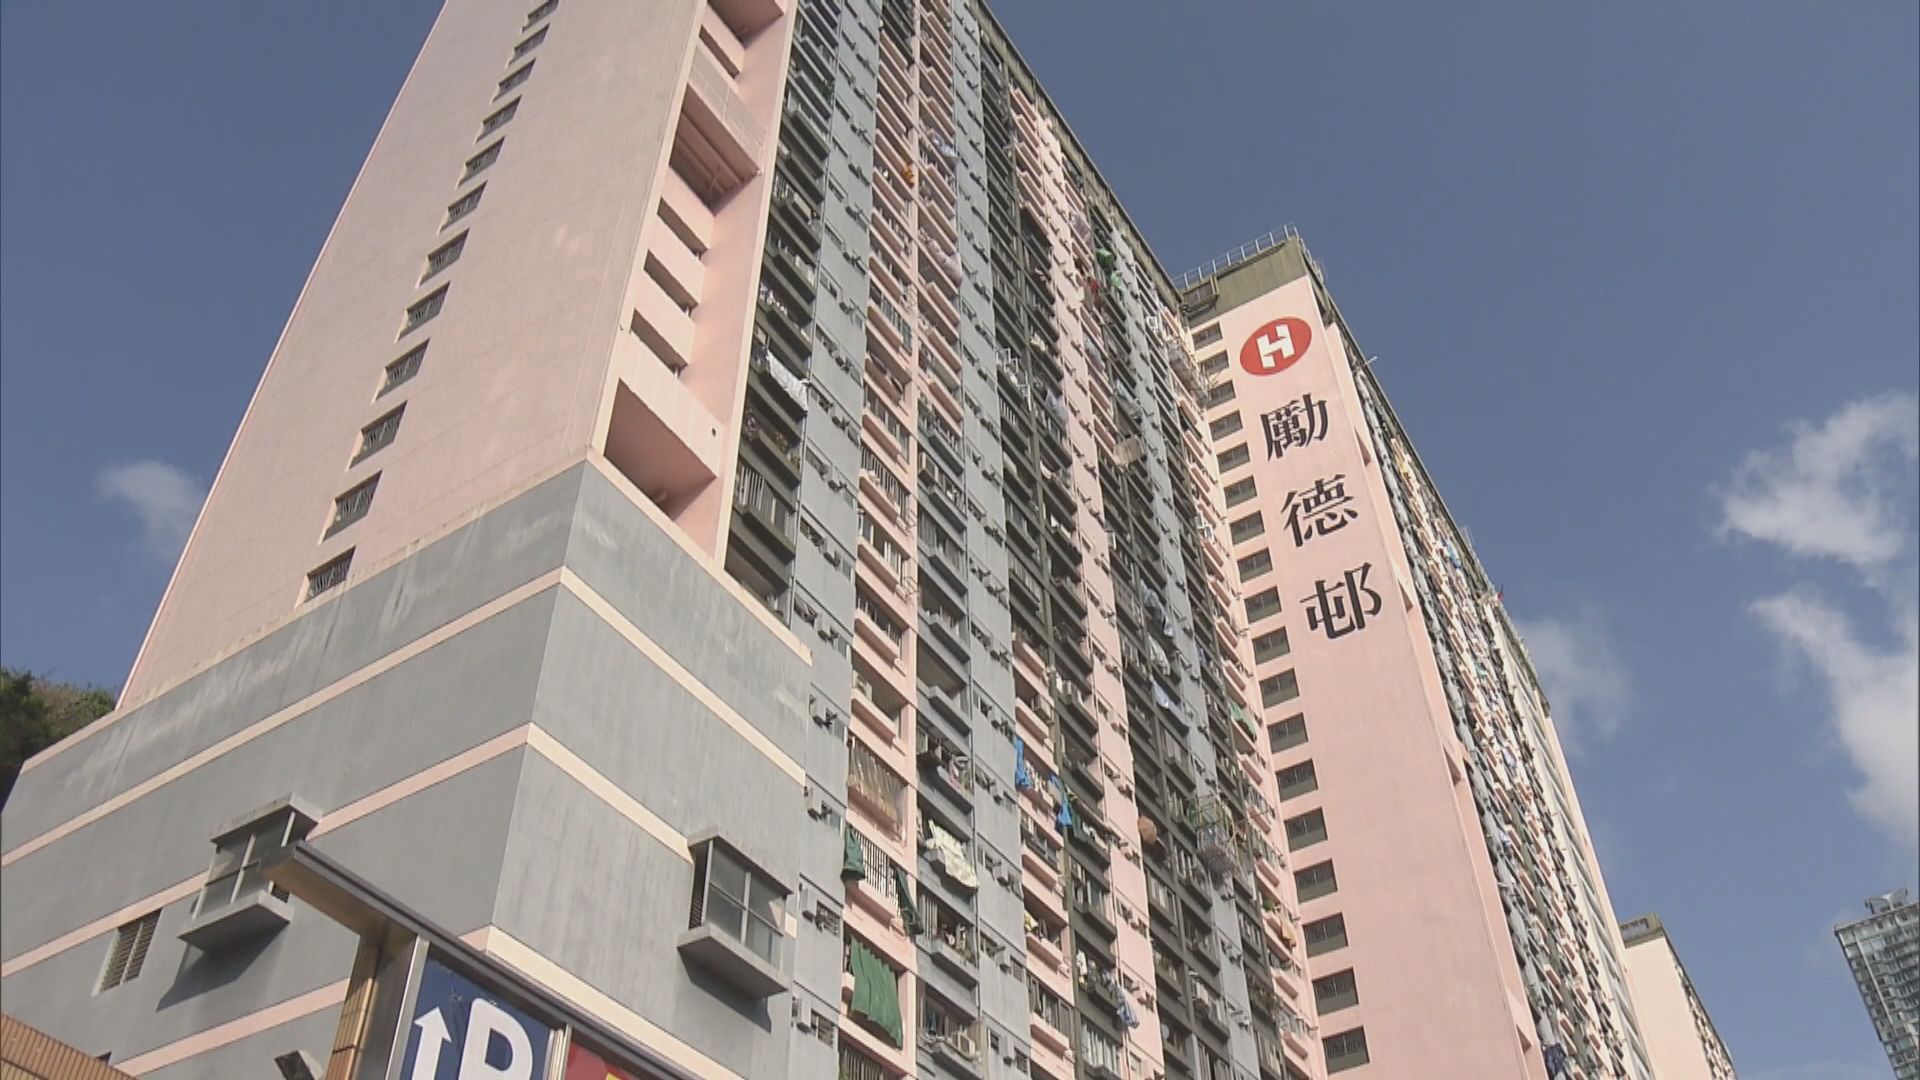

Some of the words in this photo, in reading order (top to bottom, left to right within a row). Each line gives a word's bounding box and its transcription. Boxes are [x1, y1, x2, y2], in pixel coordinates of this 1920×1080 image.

[1256, 324, 1295, 368] H
[1260, 393, 1382, 639] 勵德邨
